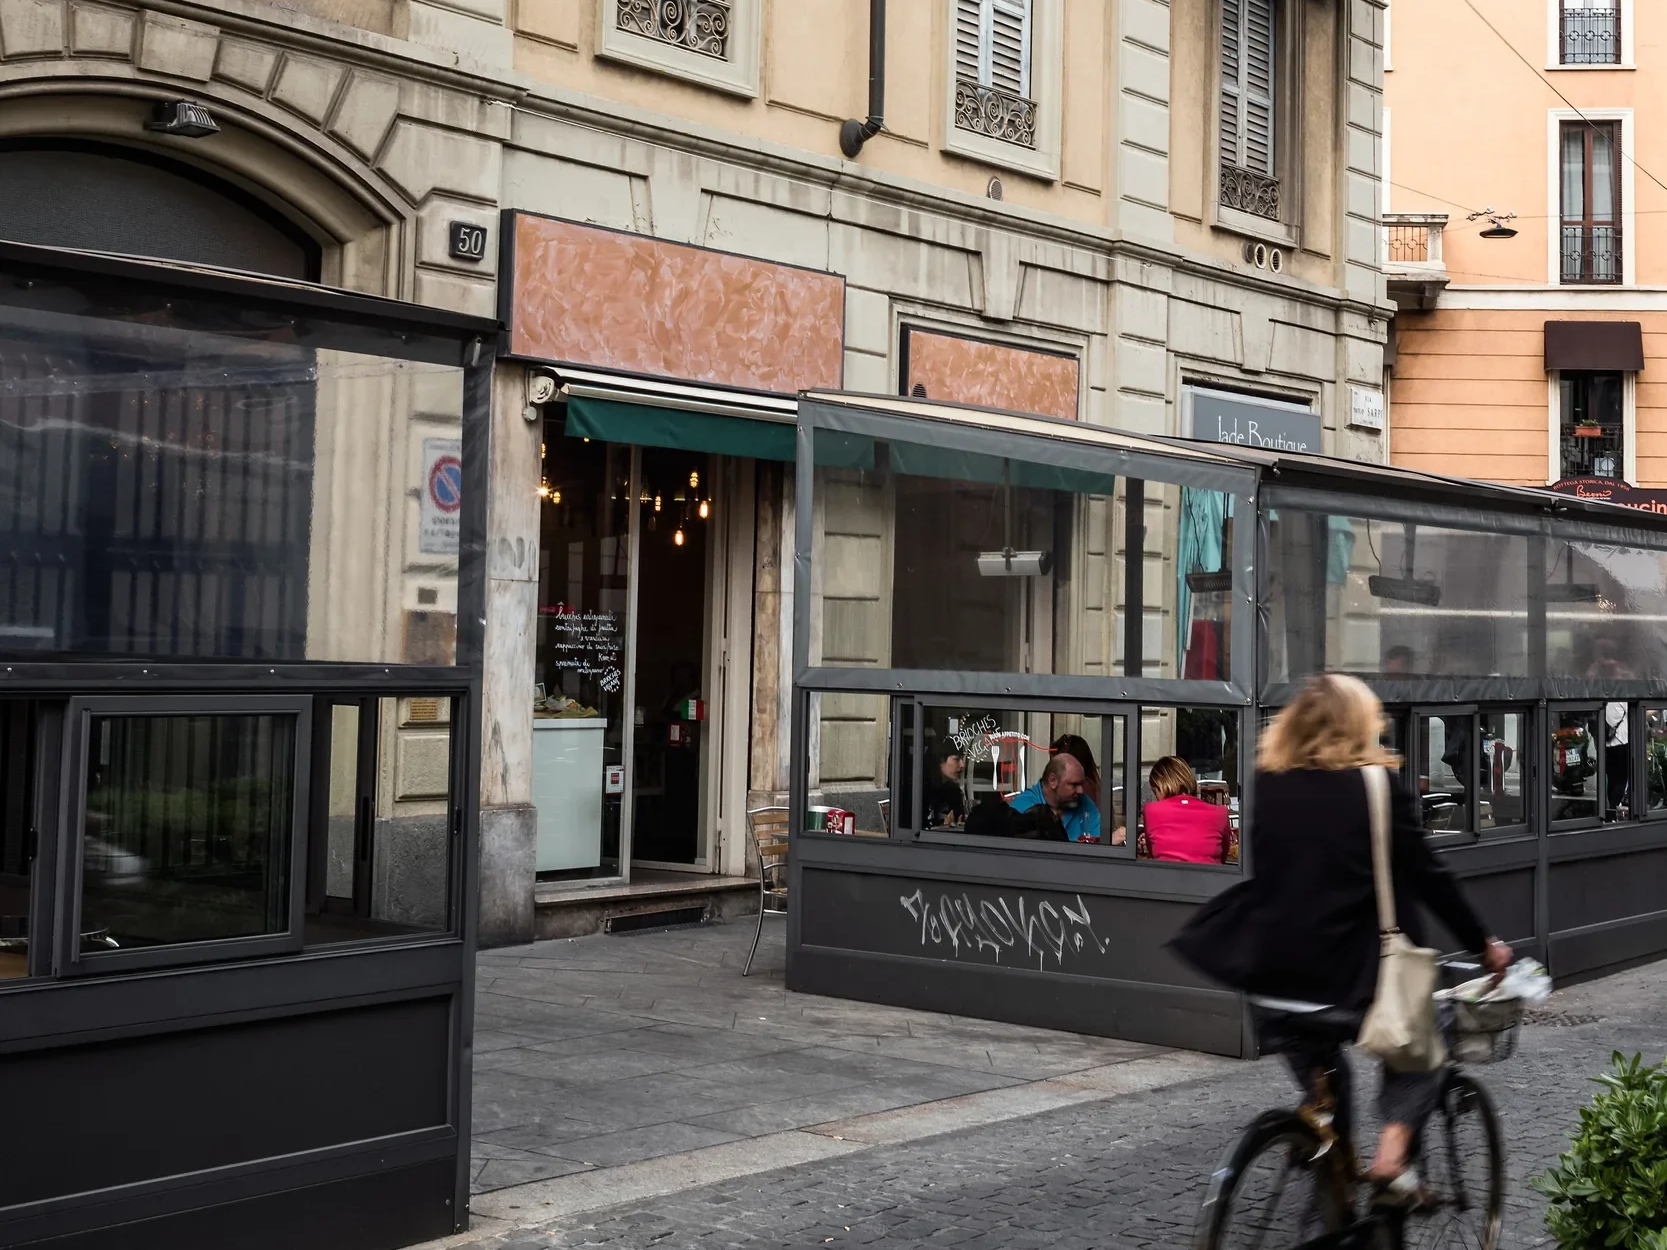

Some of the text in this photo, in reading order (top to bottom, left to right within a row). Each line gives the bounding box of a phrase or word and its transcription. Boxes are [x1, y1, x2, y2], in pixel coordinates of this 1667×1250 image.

[459, 227, 482, 254] 50
[1367, 407, 1383, 419] SARPI
[1552, 480, 1578, 490] BOTTEGA
[1618, 499, 1667, 515] cin
[949, 714, 997, 750] BRIOCHES
